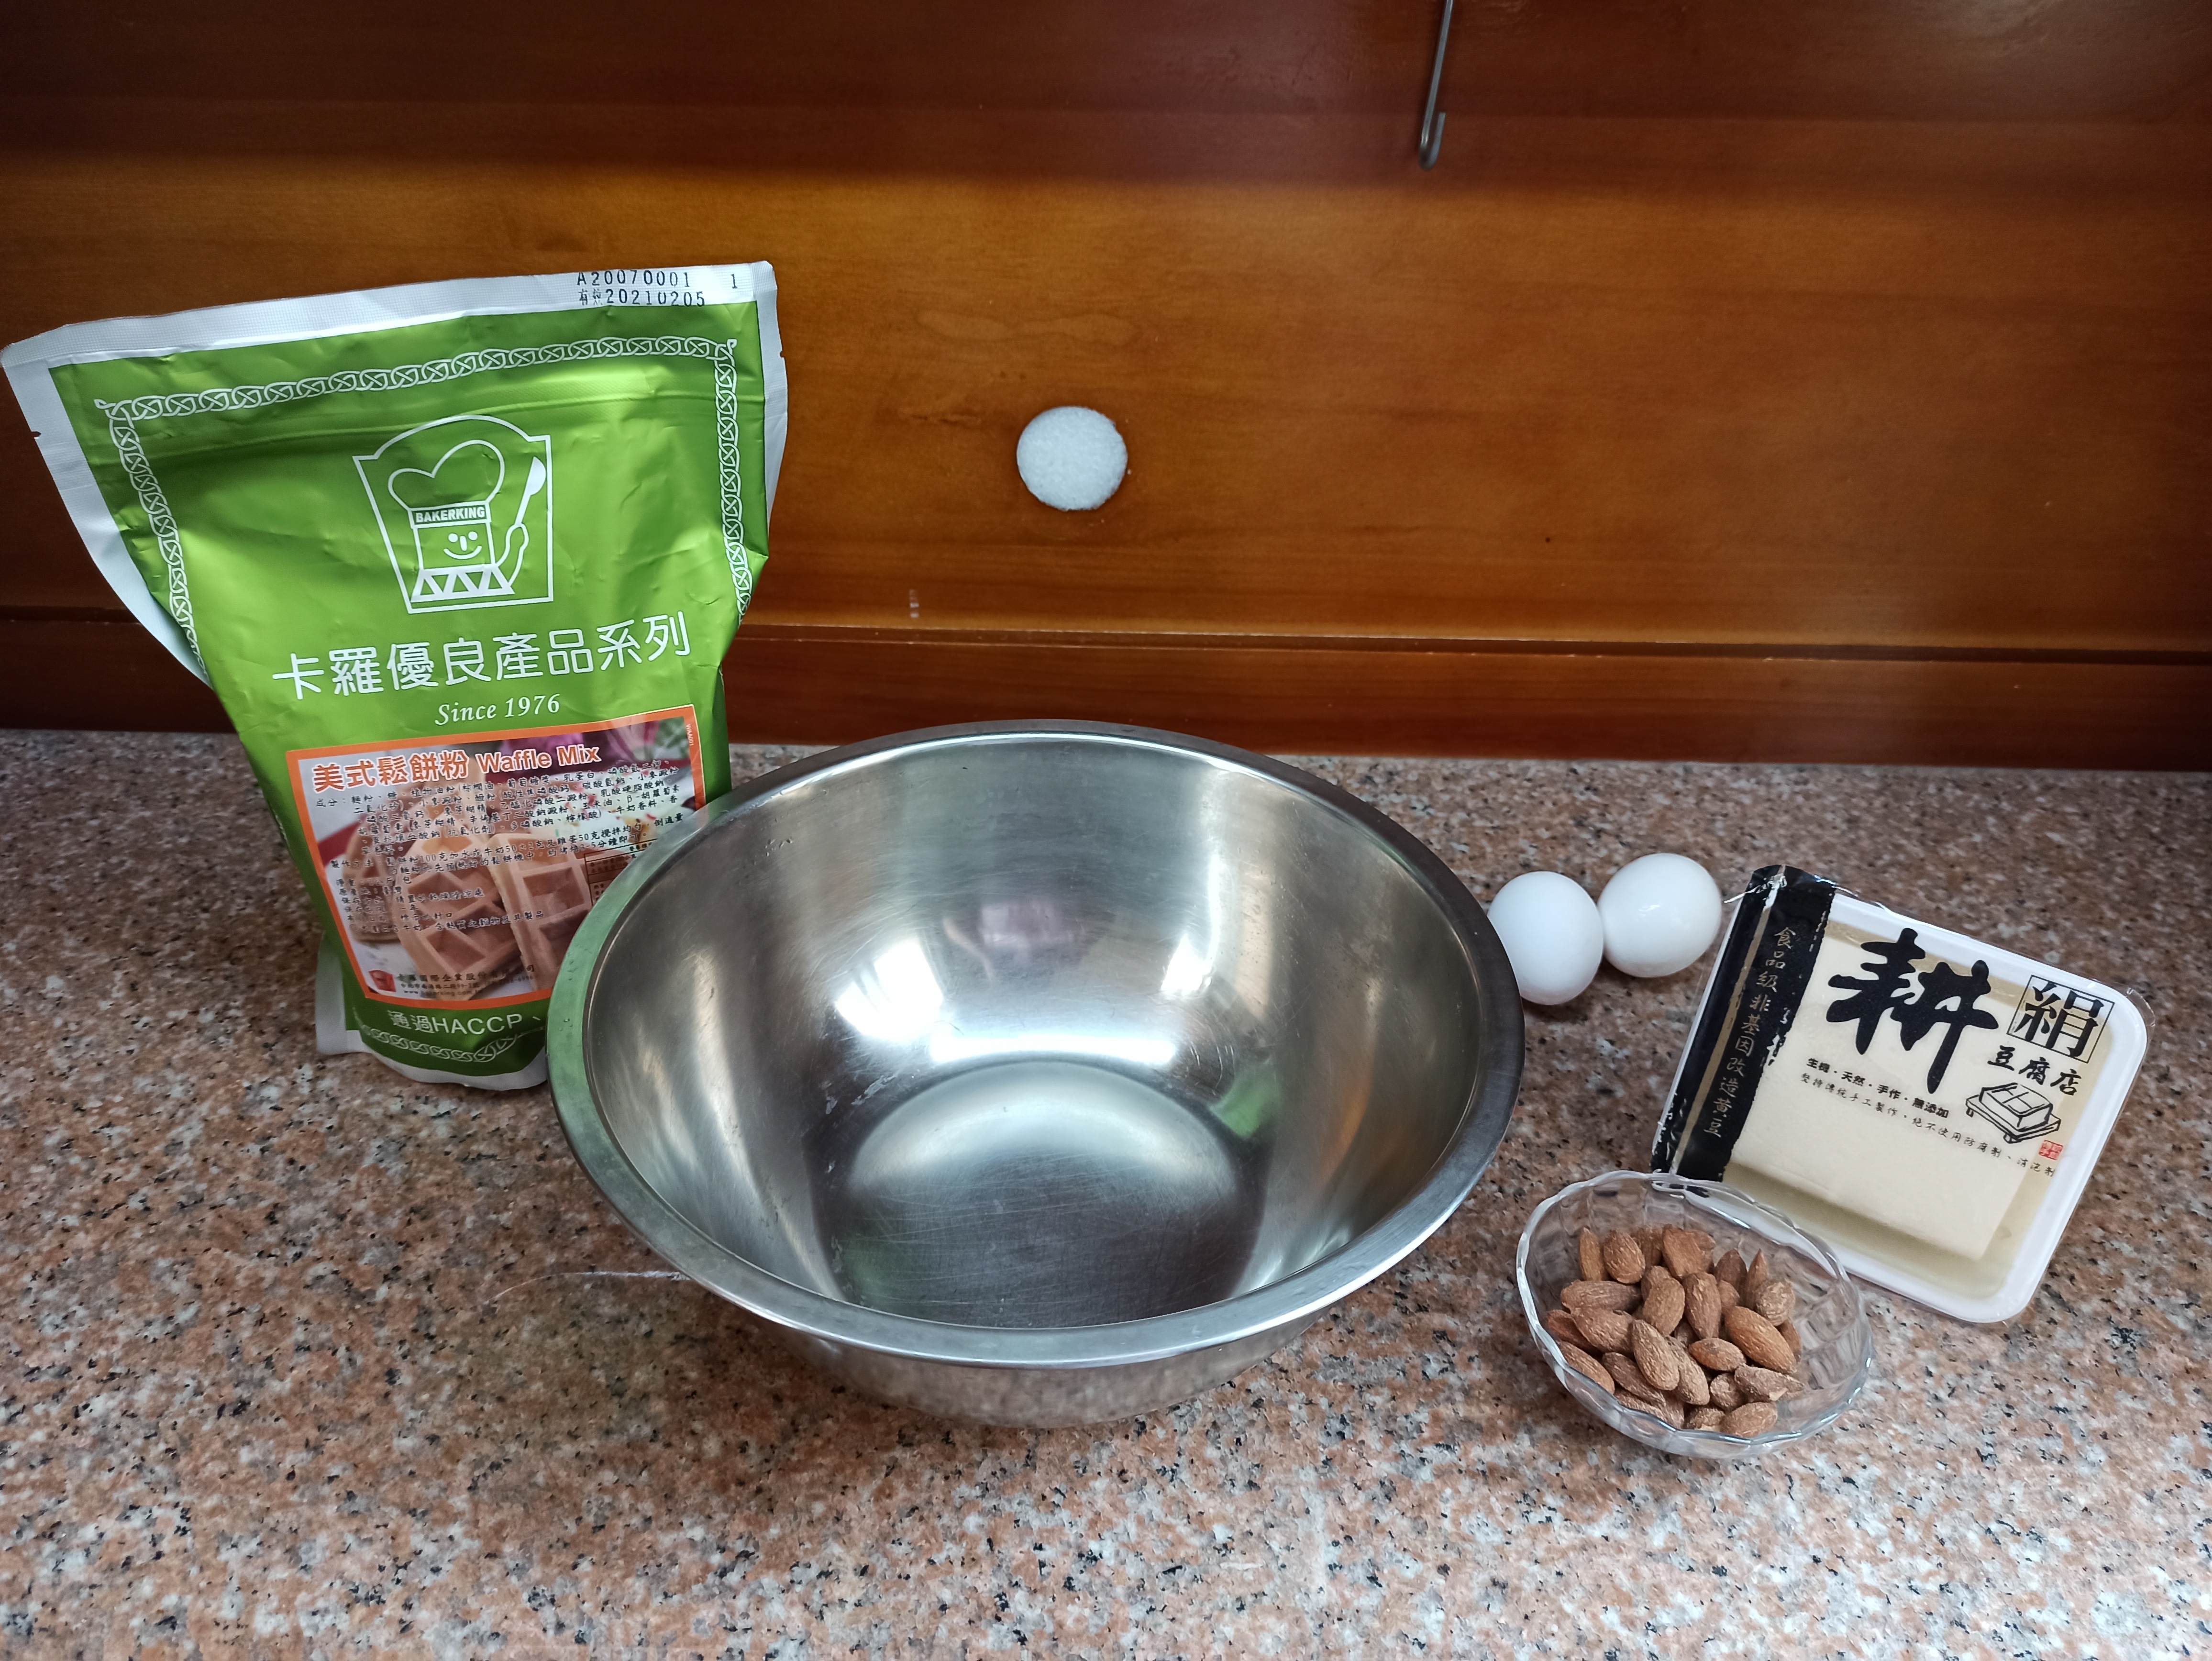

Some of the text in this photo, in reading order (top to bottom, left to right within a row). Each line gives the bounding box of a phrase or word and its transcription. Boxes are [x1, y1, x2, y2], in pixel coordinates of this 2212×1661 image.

[577, 269, 689, 287] A20070001
[415, 506, 486, 523] BAKERKING
[272, 611, 691, 699] 卡羅優良產品系列
[434, 693, 561, 726] Since 1976
[313, 744, 601, 793] 美式鬆餅粉 Waffle Mix
[1703, 927, 1796, 1138] 食品級非基因改造黃豆
[1826, 927, 1999, 1094] 耕
[2015, 981, 2105, 1058] 絹
[1988, 1045, 2082, 1096] 豆腐店
